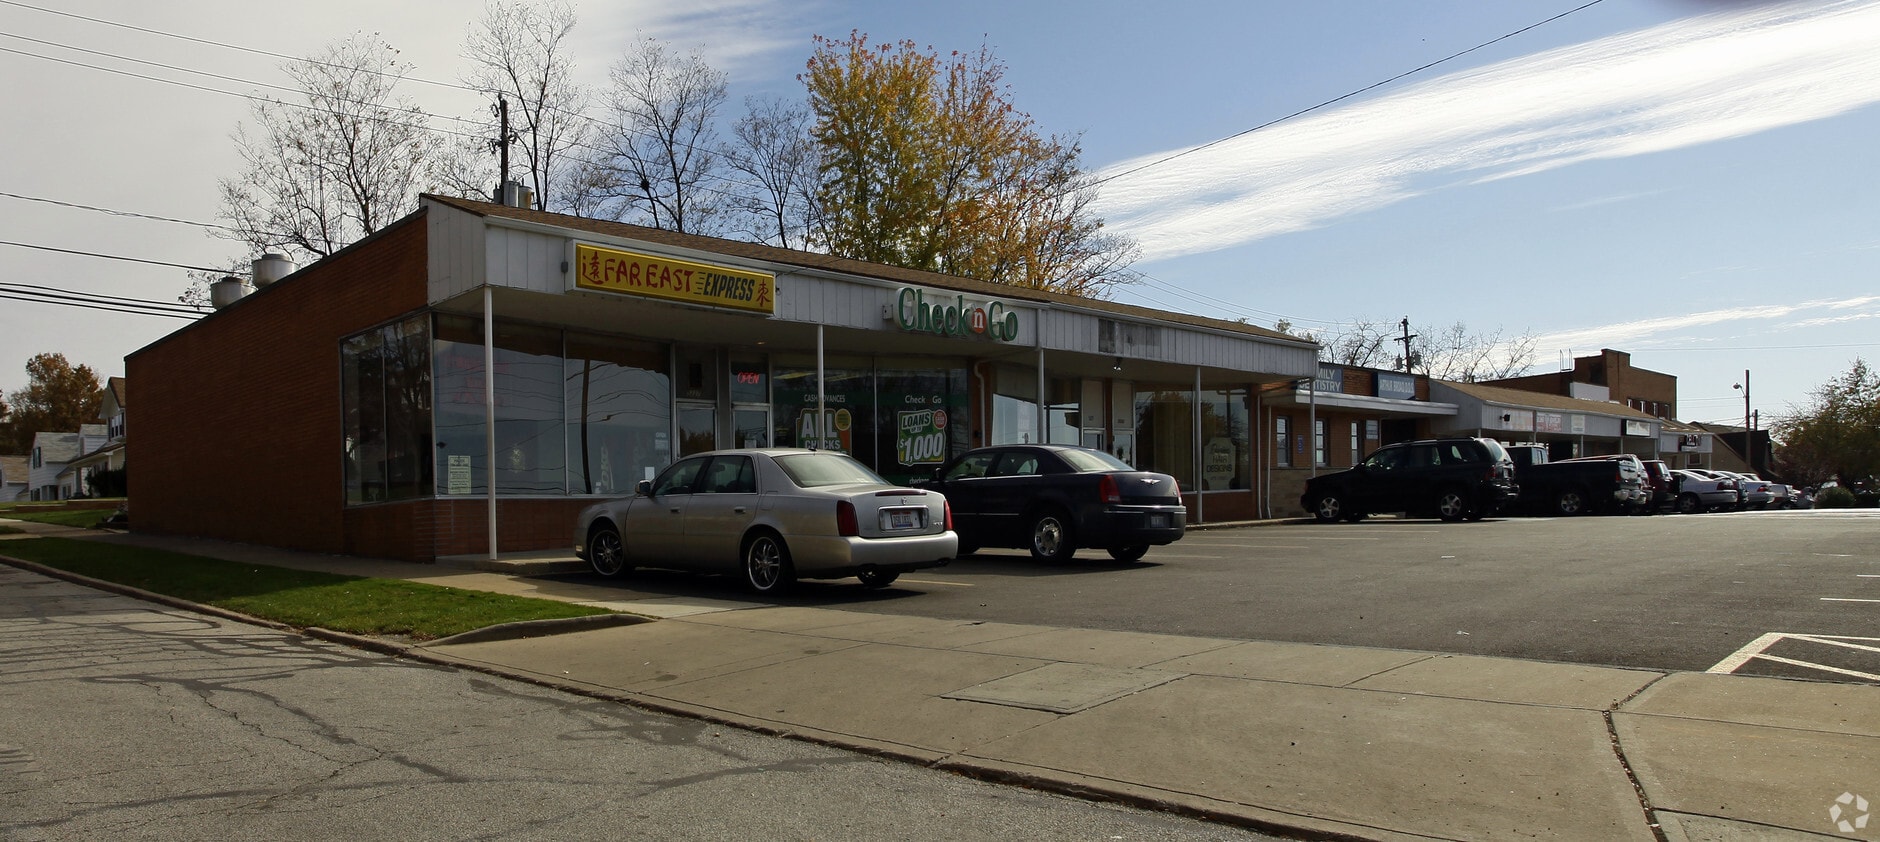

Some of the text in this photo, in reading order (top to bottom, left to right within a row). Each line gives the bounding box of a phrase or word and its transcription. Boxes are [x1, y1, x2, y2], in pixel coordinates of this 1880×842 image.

[604, 258, 756, 301] FAR EAST EXPRESS
[899, 287, 970, 337] Check
[987, 301, 1018, 342] Go
[737, 371, 760, 384] OPEN
[804, 394, 818, 402] CASH
[904, 395, 942, 404] Check Go
[902, 412, 930, 429] LOANS
[804, 440, 841, 450] CHCKS
[900, 432, 944, 463] $1,000
